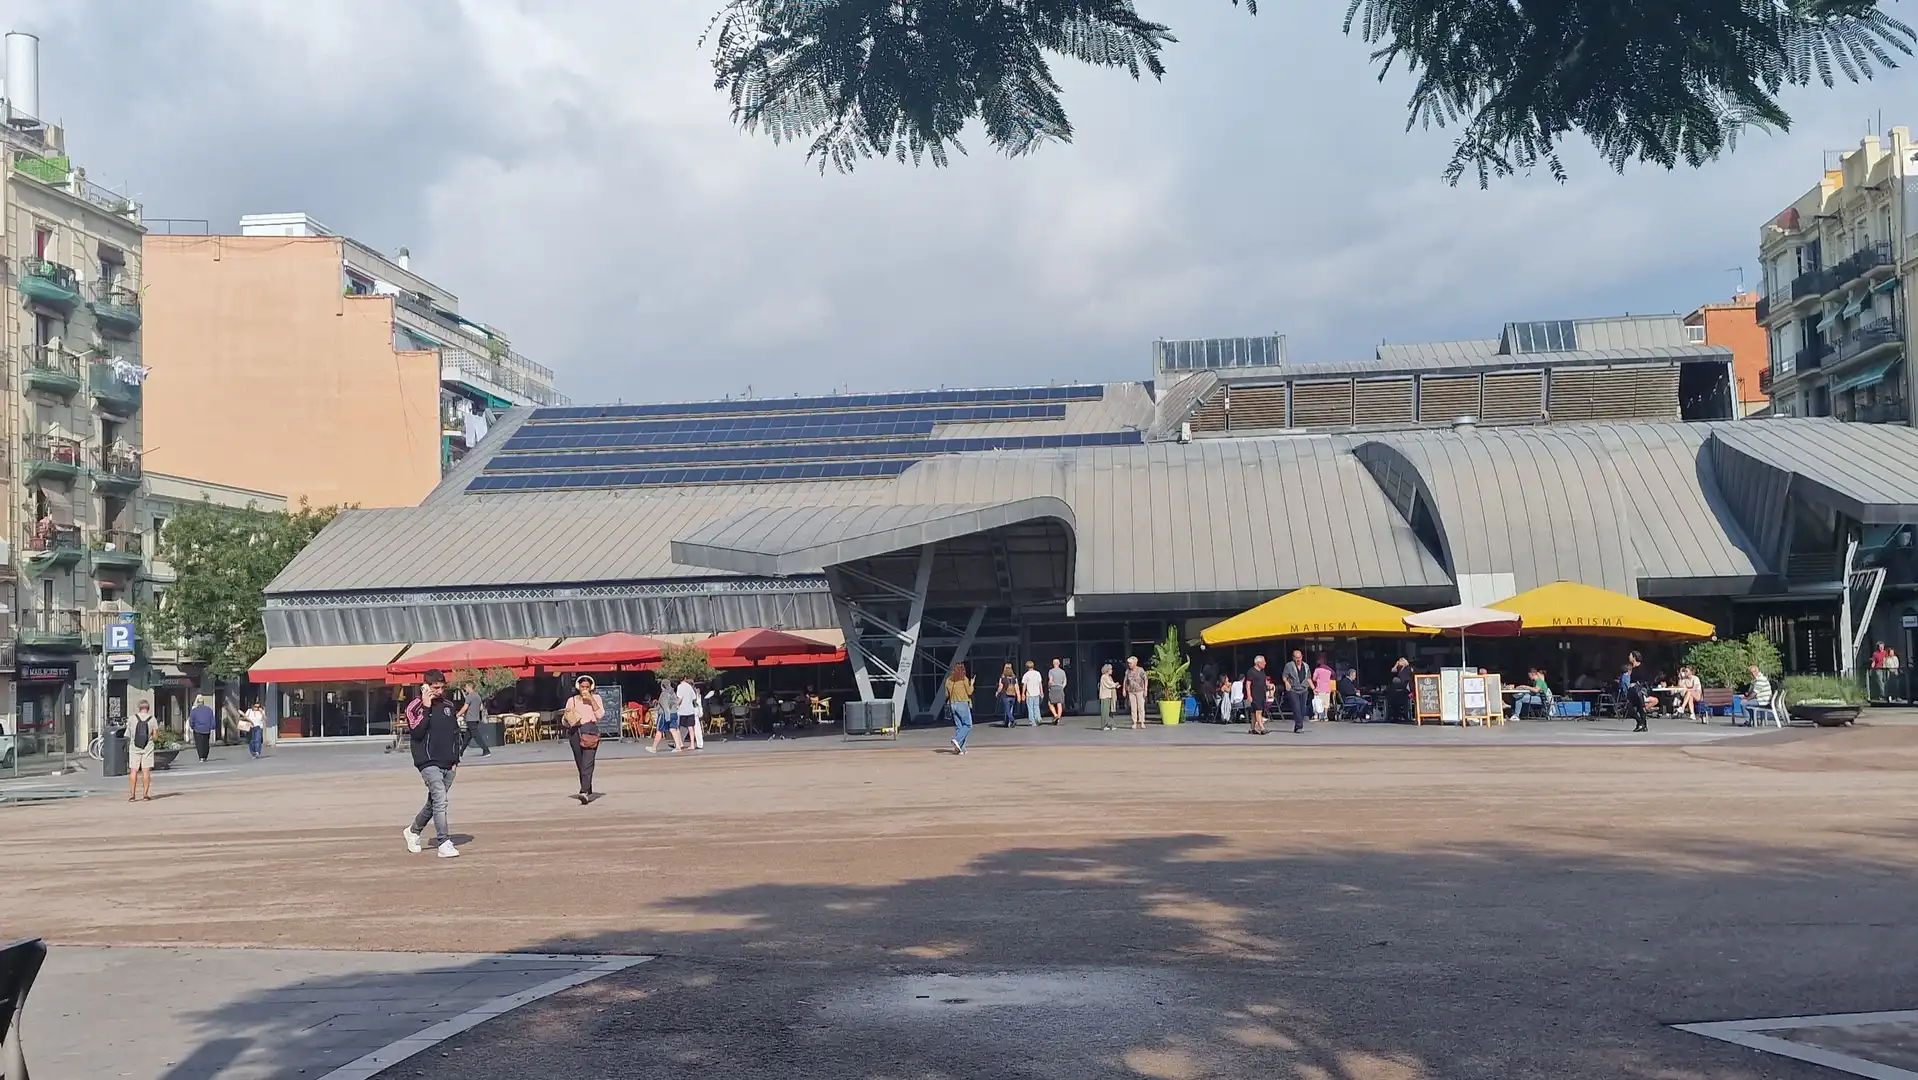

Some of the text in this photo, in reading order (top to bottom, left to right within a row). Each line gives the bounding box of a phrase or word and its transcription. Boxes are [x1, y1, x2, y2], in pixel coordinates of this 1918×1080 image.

[1552, 617, 1623, 626] MARISMA
[1290, 622, 1358, 632] MARISMA
[112, 626, 128, 647] P
